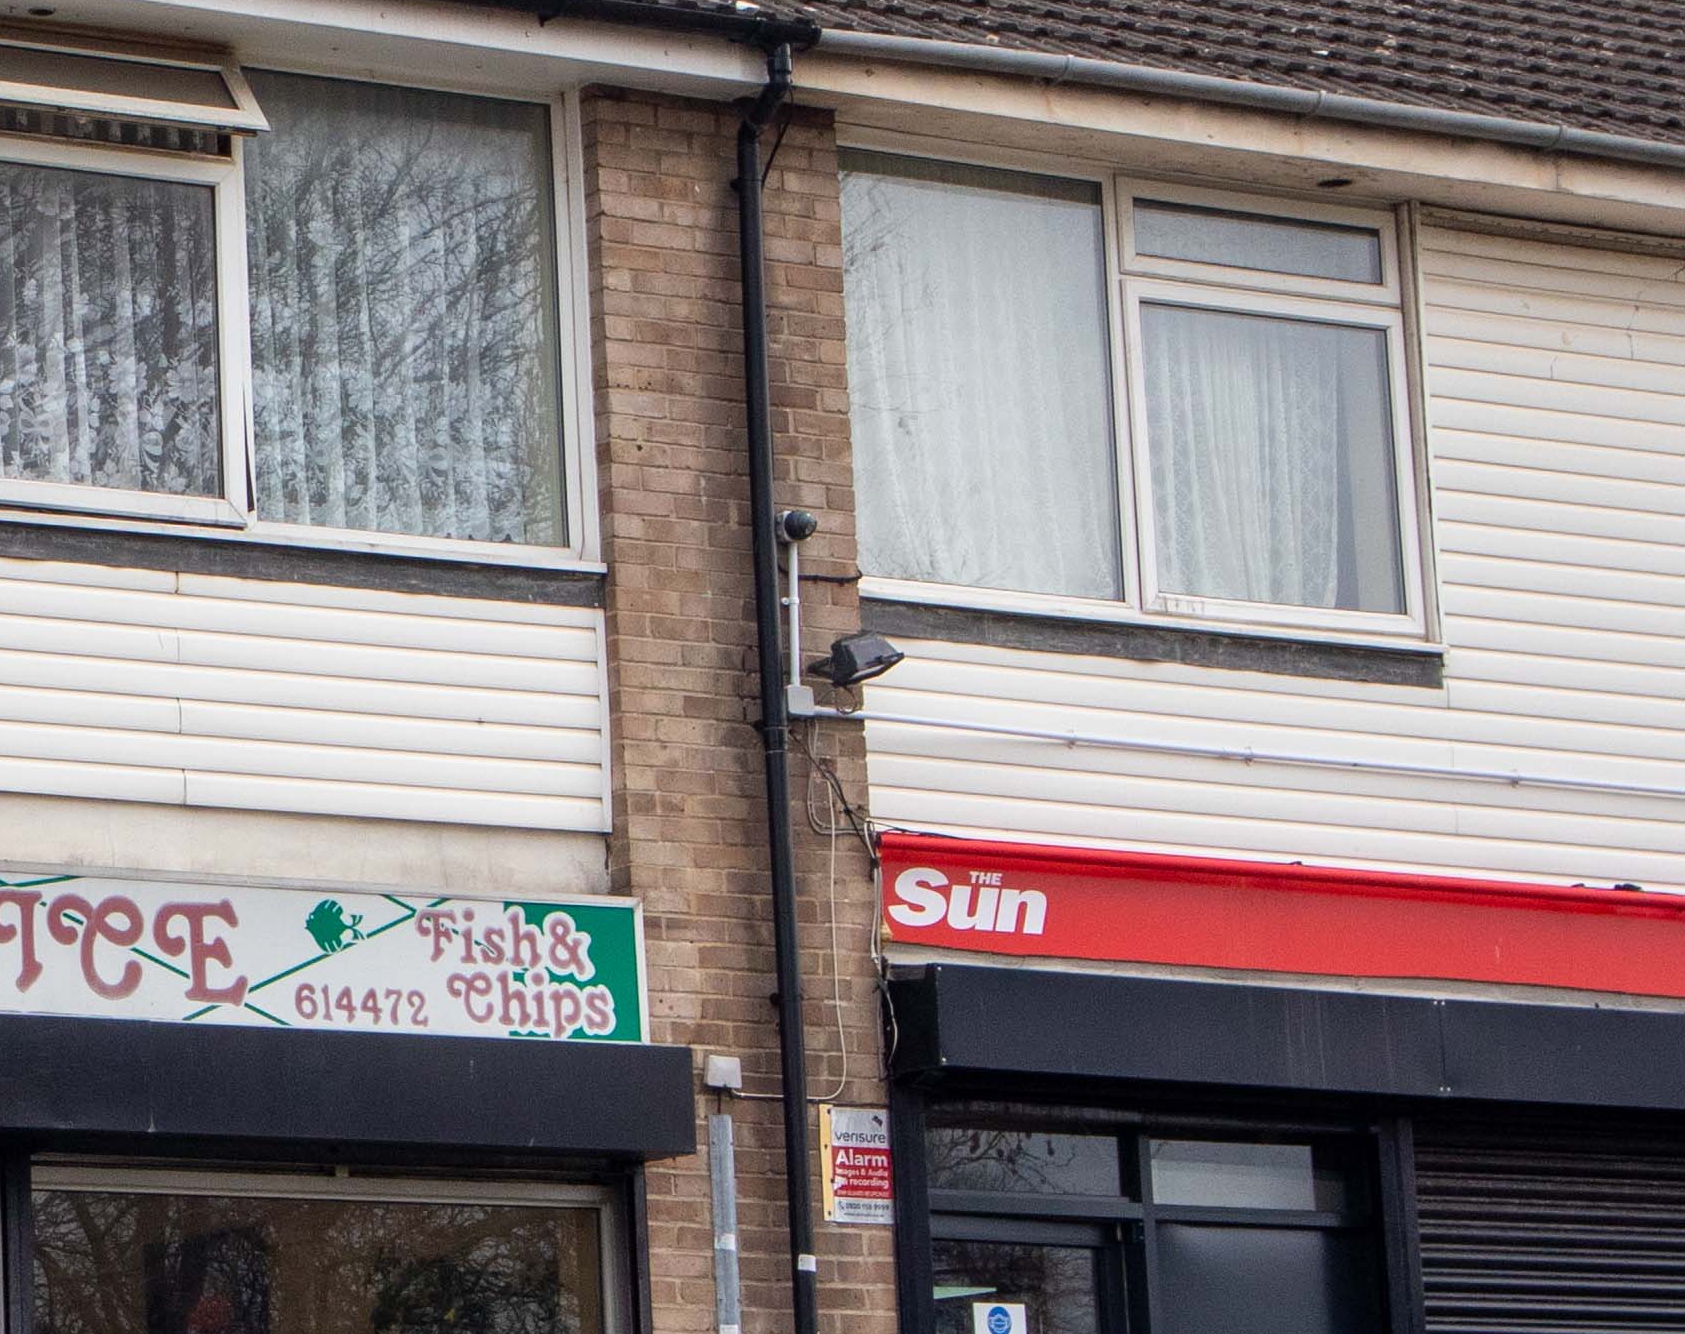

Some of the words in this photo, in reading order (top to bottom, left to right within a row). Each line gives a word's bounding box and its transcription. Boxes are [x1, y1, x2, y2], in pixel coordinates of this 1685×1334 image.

[969, 870, 1003, 886] THE
[888, 867, 1048, 936] Sun
[294, 982, 429, 1027] 614472
[446, 971, 612, 1038] Chips
[834, 1148, 889, 1166] Alarm
